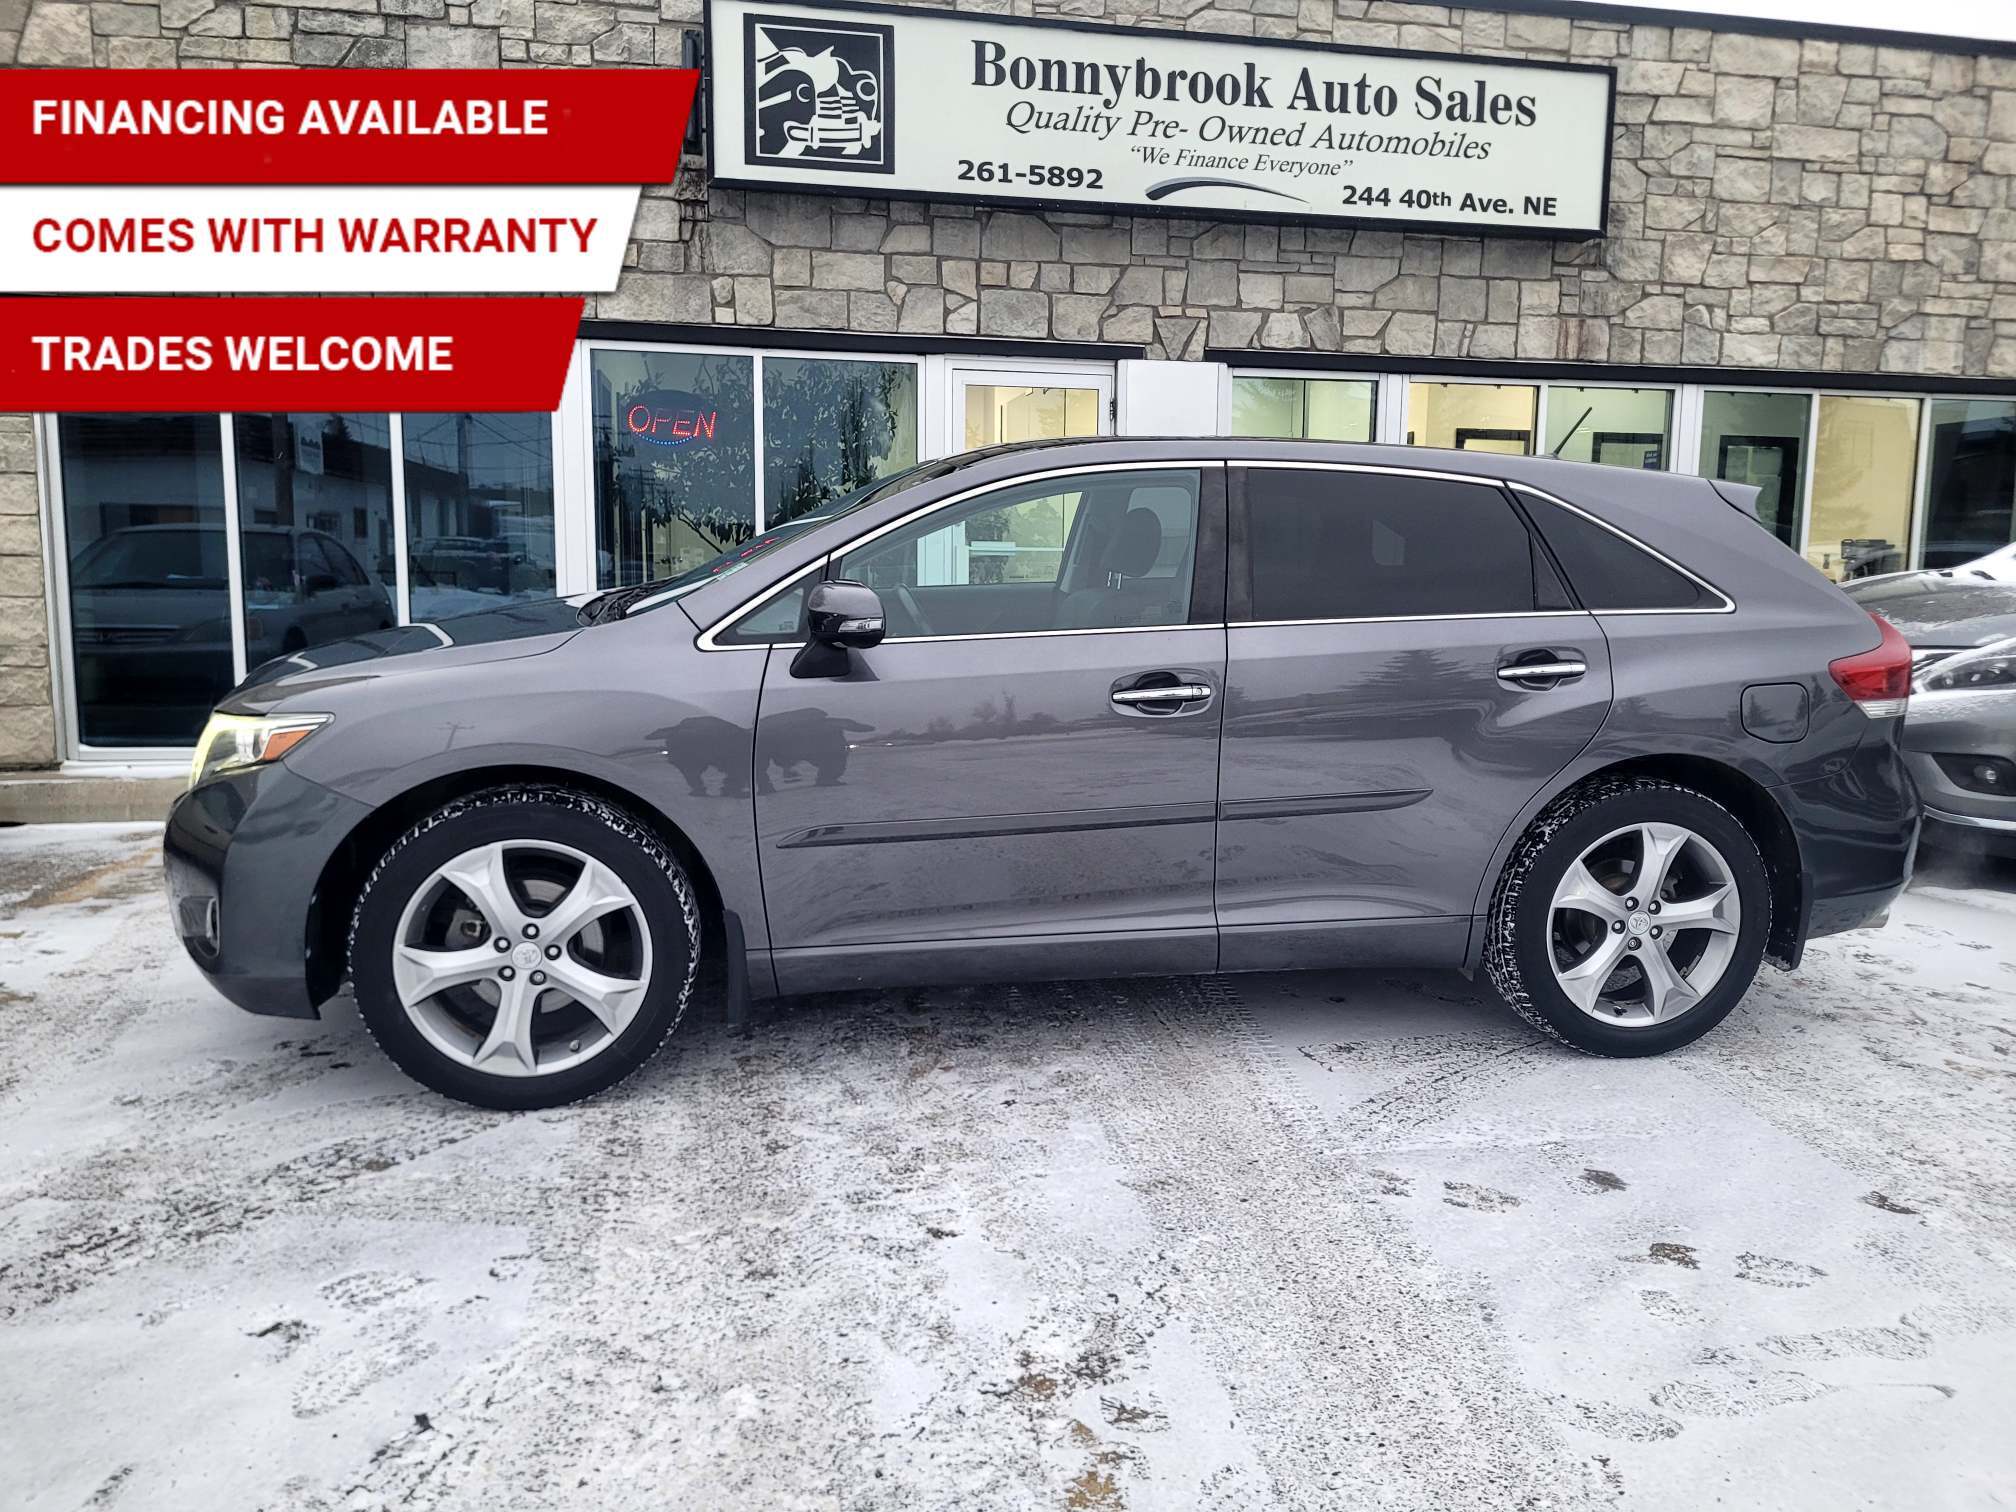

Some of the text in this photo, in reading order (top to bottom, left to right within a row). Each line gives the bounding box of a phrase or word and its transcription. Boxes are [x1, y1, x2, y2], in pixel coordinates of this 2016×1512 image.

[971, 39, 1537, 127] Bonnybrook Auto Sales
[1006, 100, 1492, 160] Quality Pre- Owned Automobiles
[957, 159, 1104, 190] 261-5892
[1130, 145, 1354, 178] “We Finance Everyone”
[1341, 185, 1558, 217] 244 40th Ave. NE
[627, 403, 717, 440] OPEN
